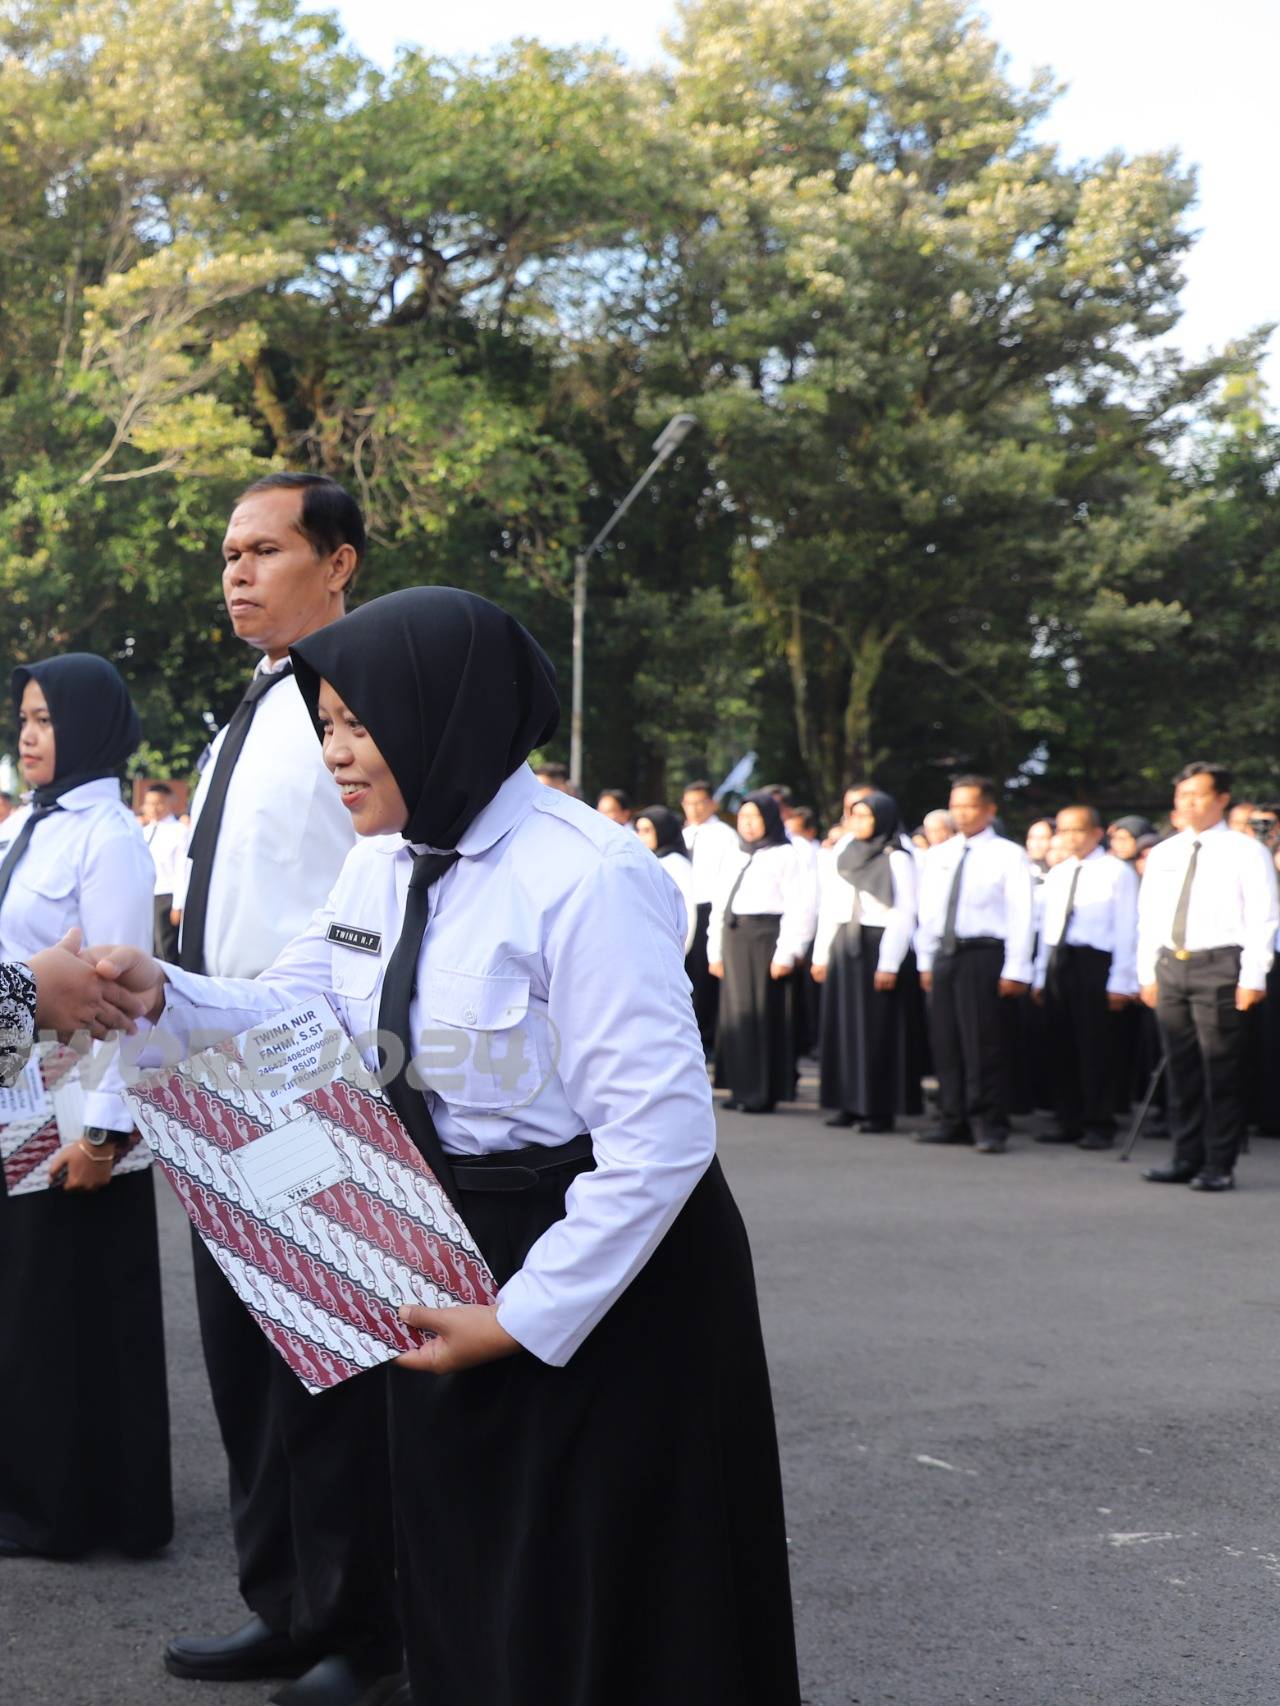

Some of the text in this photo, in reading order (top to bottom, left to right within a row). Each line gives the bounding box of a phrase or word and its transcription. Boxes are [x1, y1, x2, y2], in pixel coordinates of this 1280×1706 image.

[335, 929, 358, 942] TWINA
[254, 1010, 317, 1046] TWINA NUR
[259, 1023, 324, 1060] FAHMI, S.ST
[270, 1053, 351, 1098] dr. TJITROWARDOJO
[292, 1056, 317, 1073] RSUD
[287, 1187, 309, 1200] VIS
